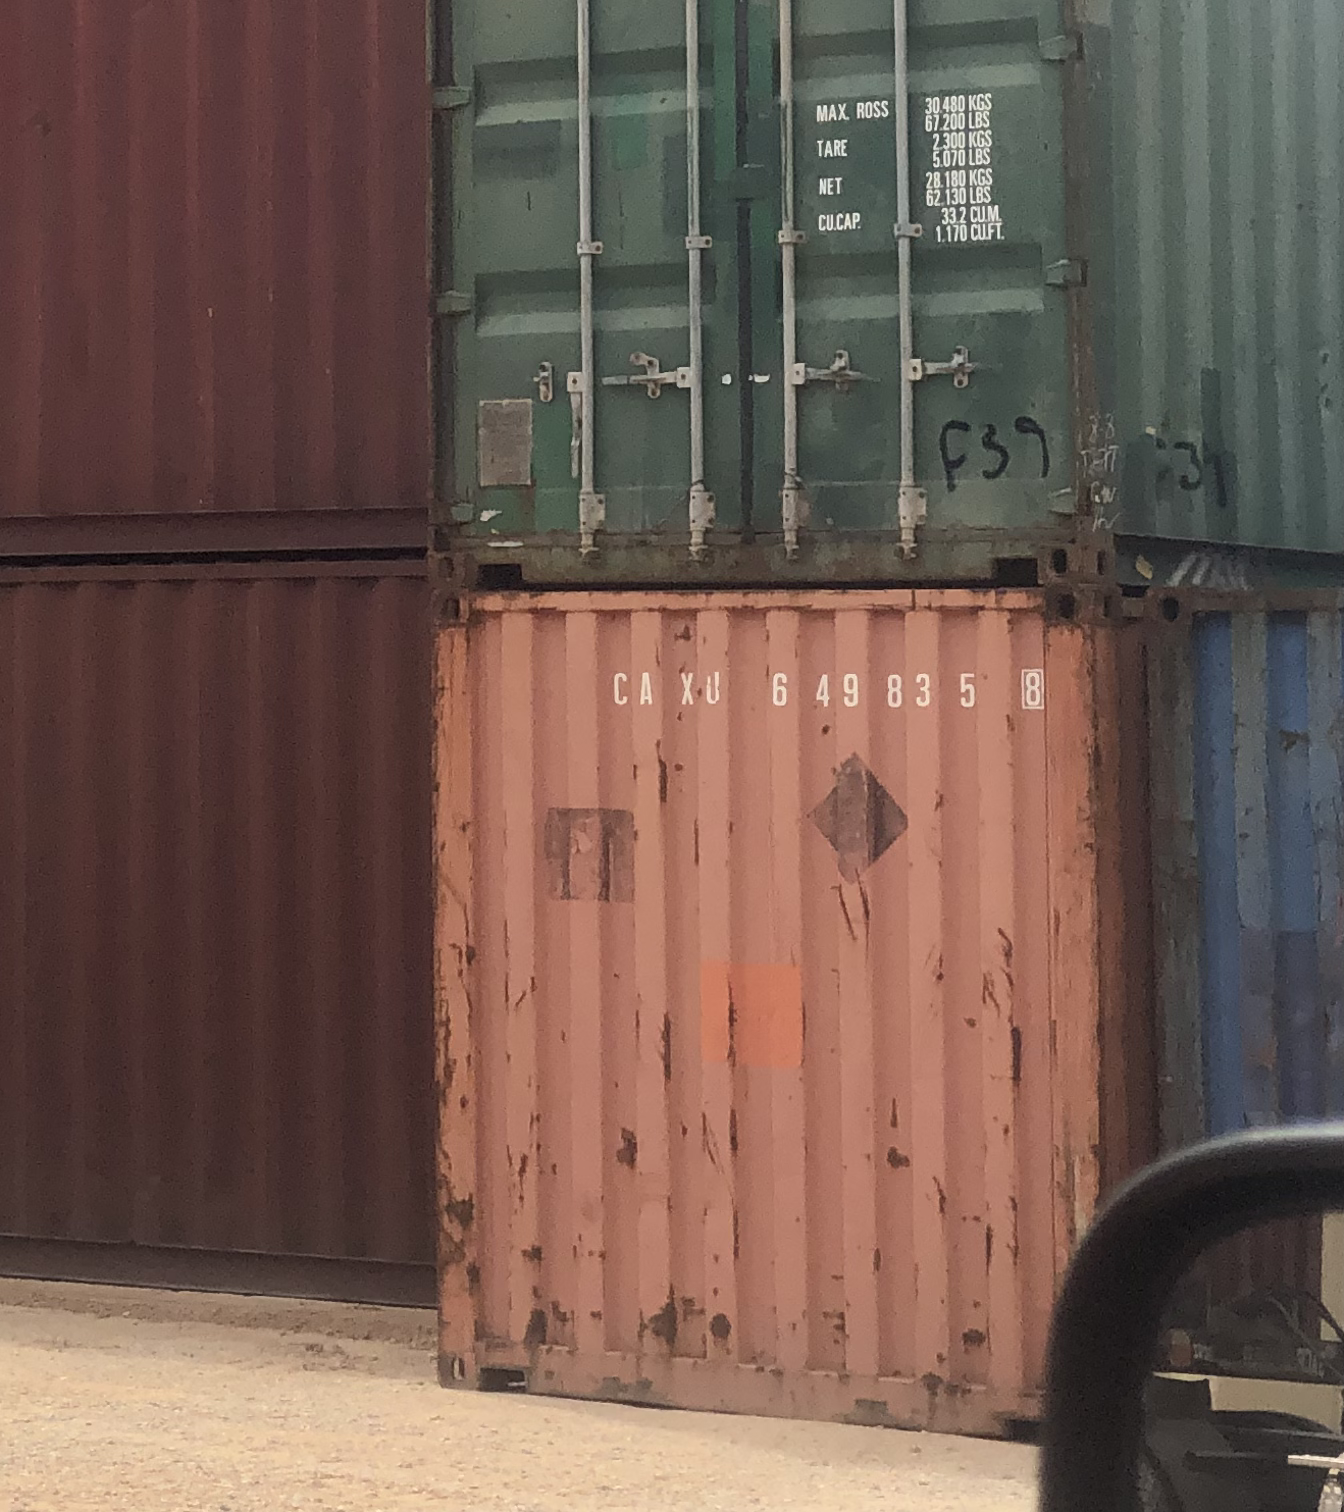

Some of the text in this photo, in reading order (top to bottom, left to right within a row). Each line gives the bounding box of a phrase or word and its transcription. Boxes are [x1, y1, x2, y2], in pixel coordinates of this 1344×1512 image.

[816, 93, 992, 122] MAX. ROSS 30.480 KGS
[925, 111, 990, 132] 67.200 LBS
[817, 130, 992, 157] TARE 2.300 KGS
[933, 148, 990, 168] 5.070 LBS
[819, 168, 993, 195] NET 28.180 KGS
[926, 187, 991, 206] 62.130 LBS
[818, 213, 861, 231] CU.CAP.
[941, 207, 966, 224] 33.2
[936, 225, 967, 242] 1.170
[614, 672, 720, 705] CAXU
[1024, 671, 1042, 707] 8
